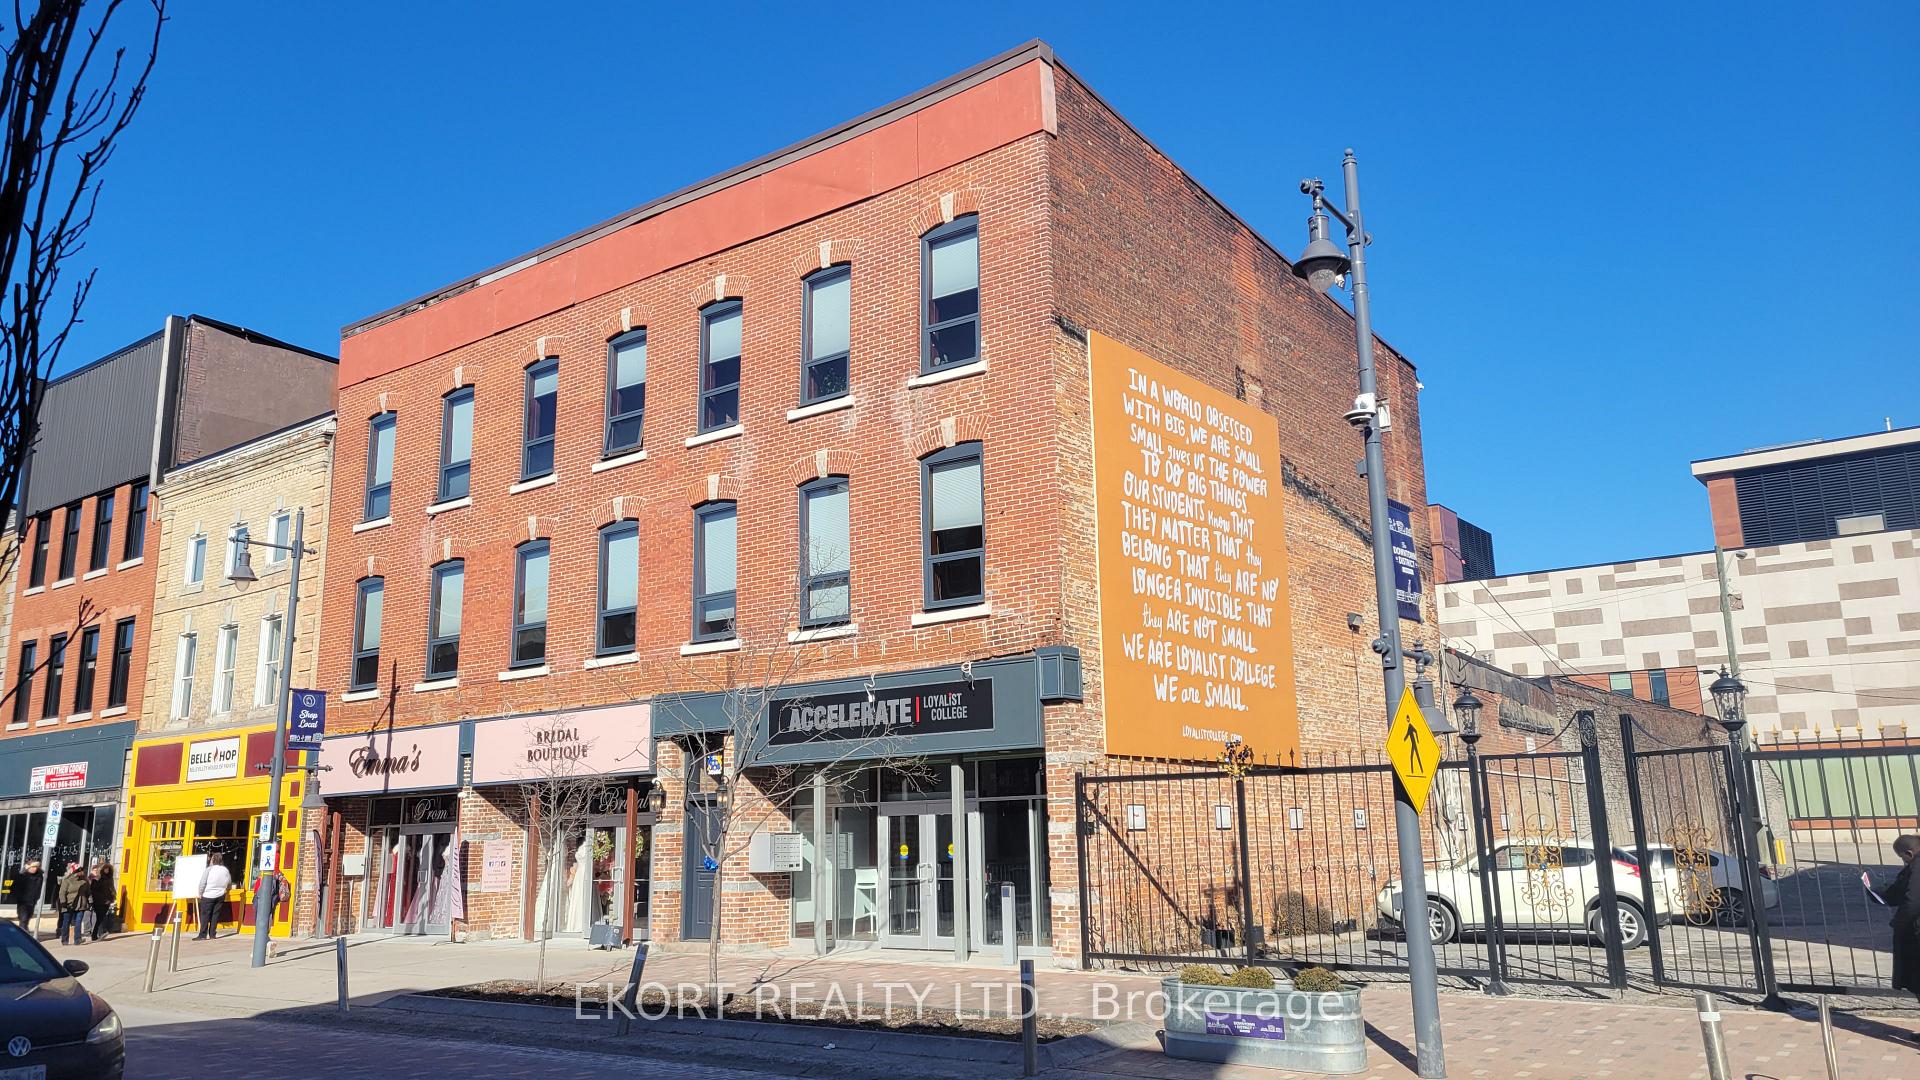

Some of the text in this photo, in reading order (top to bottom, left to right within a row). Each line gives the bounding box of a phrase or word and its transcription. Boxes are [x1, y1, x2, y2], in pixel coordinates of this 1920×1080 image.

[1127, 368, 1252, 445] IN A WORLD OBSESSED
[1123, 393, 1161, 427] WITH
[1211, 435, 1231, 458] ARE
[1235, 445, 1265, 473] SMALL.
[1130, 423, 1268, 498] SMALL gives US THE POWER
[1141, 449, 1161, 478] TO
[1165, 461, 1184, 487] DO
[1187, 472, 1207, 496] BIG
[1123, 471, 1150, 504] OUR
[1152, 484, 1205, 521] STUDENTS
[1230, 511, 1255, 542] THAT
[1121, 501, 1262, 575] THEY MATTER THAT they
[1121, 531, 1279, 602] BELONG THAT they ARE NO
[1132, 566, 1182, 603] LONGER
[1246, 602, 1273, 628] THAT
[1142, 603, 1258, 654] they ARE NOT SMALL.
[1122, 633, 1144, 662] WE
[1147, 640, 1173, 669] ARE
[1176, 645, 1226, 680] LOYALIST
[923, 692, 963, 709] LOYALIST
[1153, 674, 1249, 711] WE are SMALL.
[298, 720, 318, 728] Local
[299, 709, 318, 720] Shop
[788, 697, 912, 732] ACCELERATE
[931, 705, 968, 721] COLLEGE
[527, 744, 588, 762] BOUTIQUE
[536, 728, 579, 744] BRIDAL
[190, 750, 237, 765] BELLE HOP
[349, 744, 421, 778] Emma's
[414, 799, 448, 821] Prom
